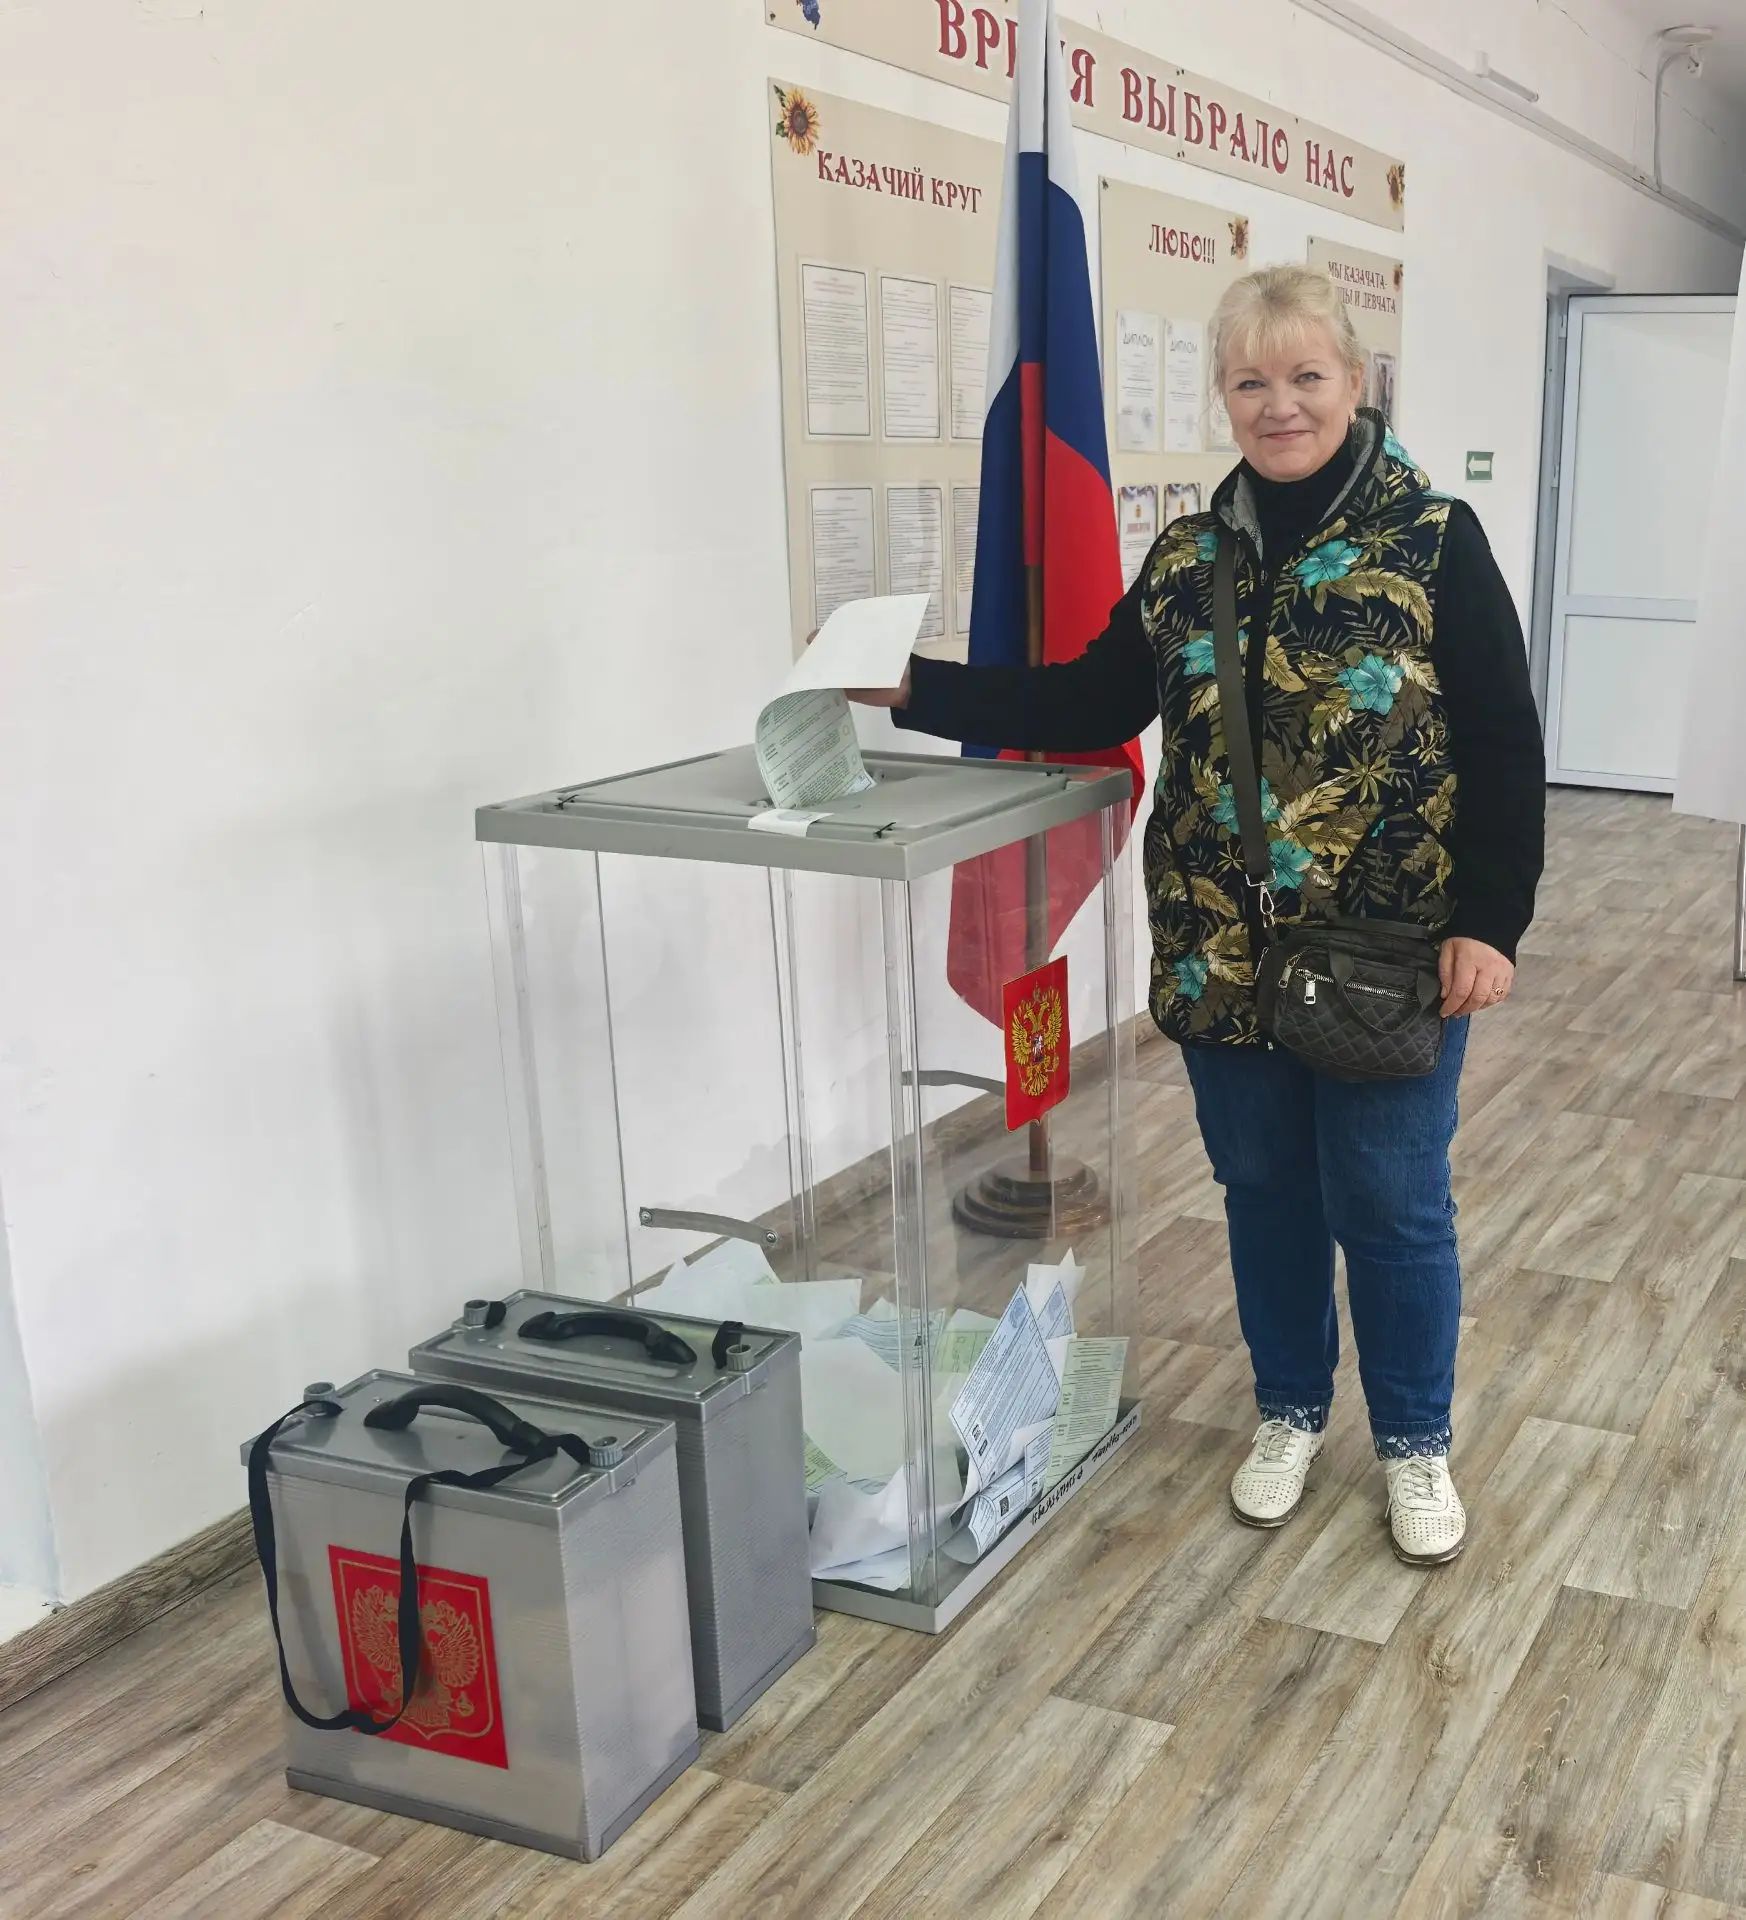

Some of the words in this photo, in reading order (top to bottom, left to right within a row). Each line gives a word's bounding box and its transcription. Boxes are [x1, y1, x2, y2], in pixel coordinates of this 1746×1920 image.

[935, 0, 1097, 107] ВРЯ
[1120, 67, 1290, 174] ВЫБРАЛО
[1304, 139, 1355, 197] НАС
[817, 150, 925, 201] КАЗАЧИЙ
[930, 177, 982, 213] КРУГ
[1148, 223, 1215, 264] ЛЮБО!!!
[1327, 260, 1342, 279] МЫ
[1361, 292, 1396, 313] ДЕВЧАТА
